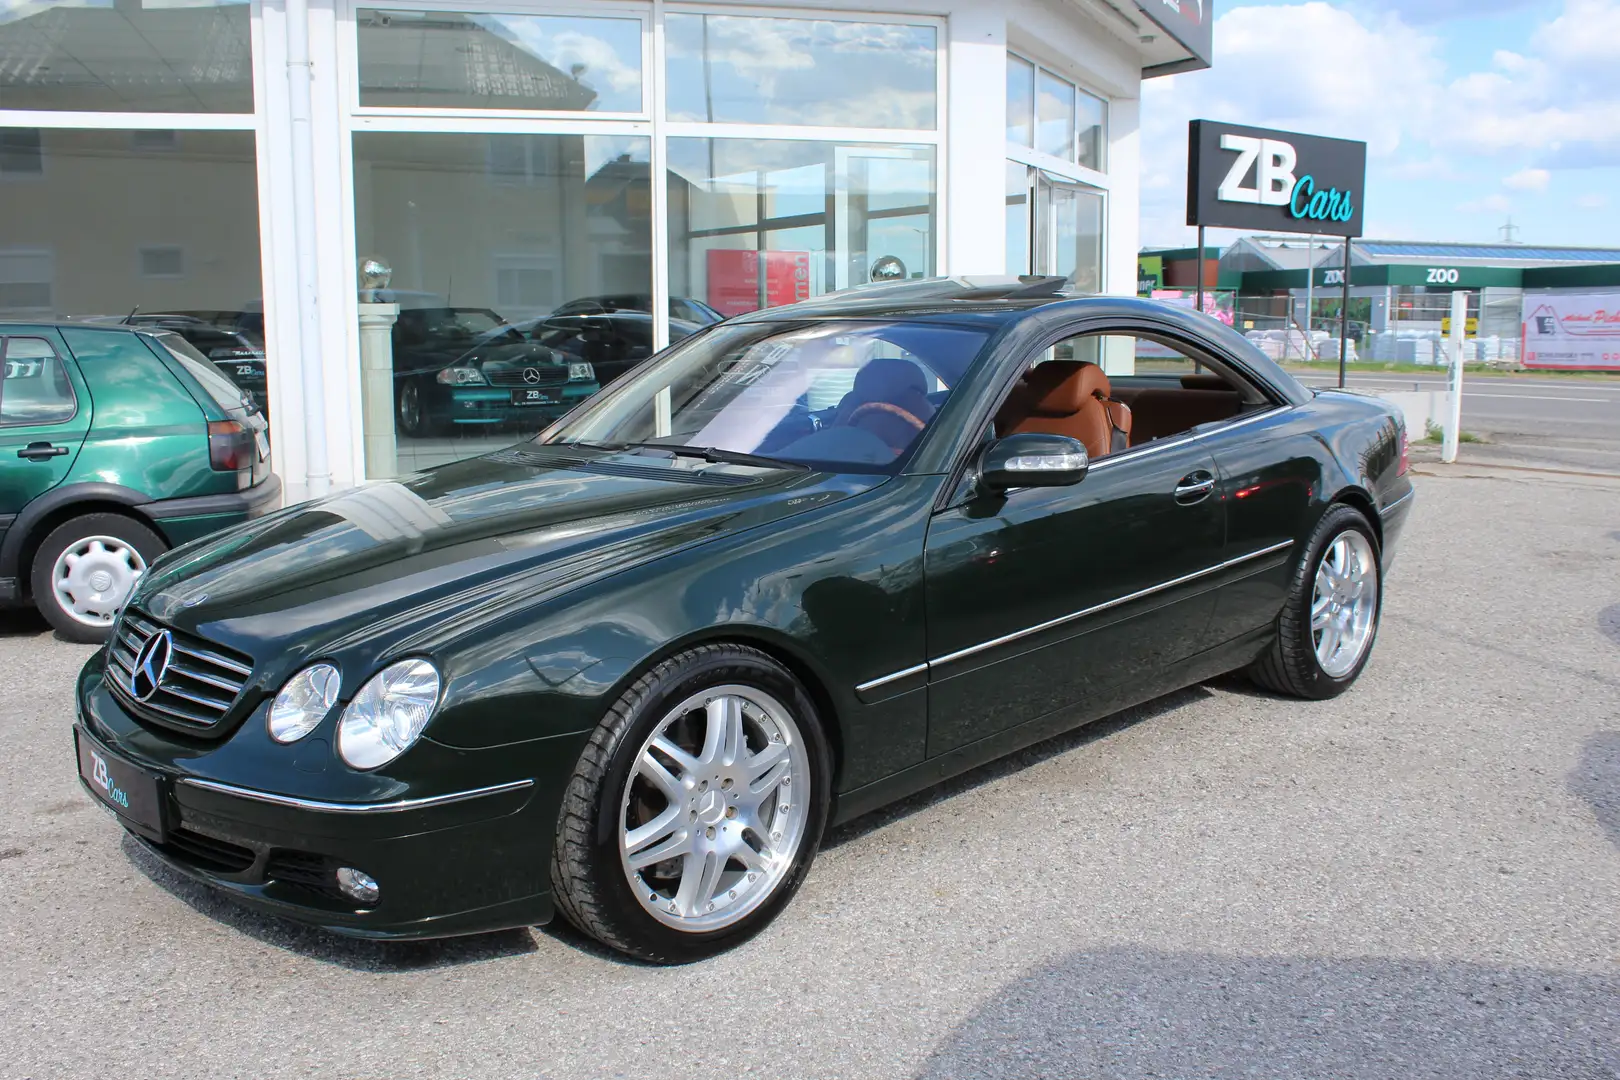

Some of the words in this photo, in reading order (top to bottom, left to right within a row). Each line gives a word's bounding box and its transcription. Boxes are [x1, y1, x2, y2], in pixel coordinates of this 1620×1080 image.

[1218, 134, 1297, 206] ZB
[1290, 175, 1354, 222] Cars
[1426, 268, 1459, 283] ZOO
[236, 365, 252, 375] ZB
[526, 390, 539, 399] ZB
[91, 750, 109, 790] ZB
[107, 778, 128, 807] Cars
